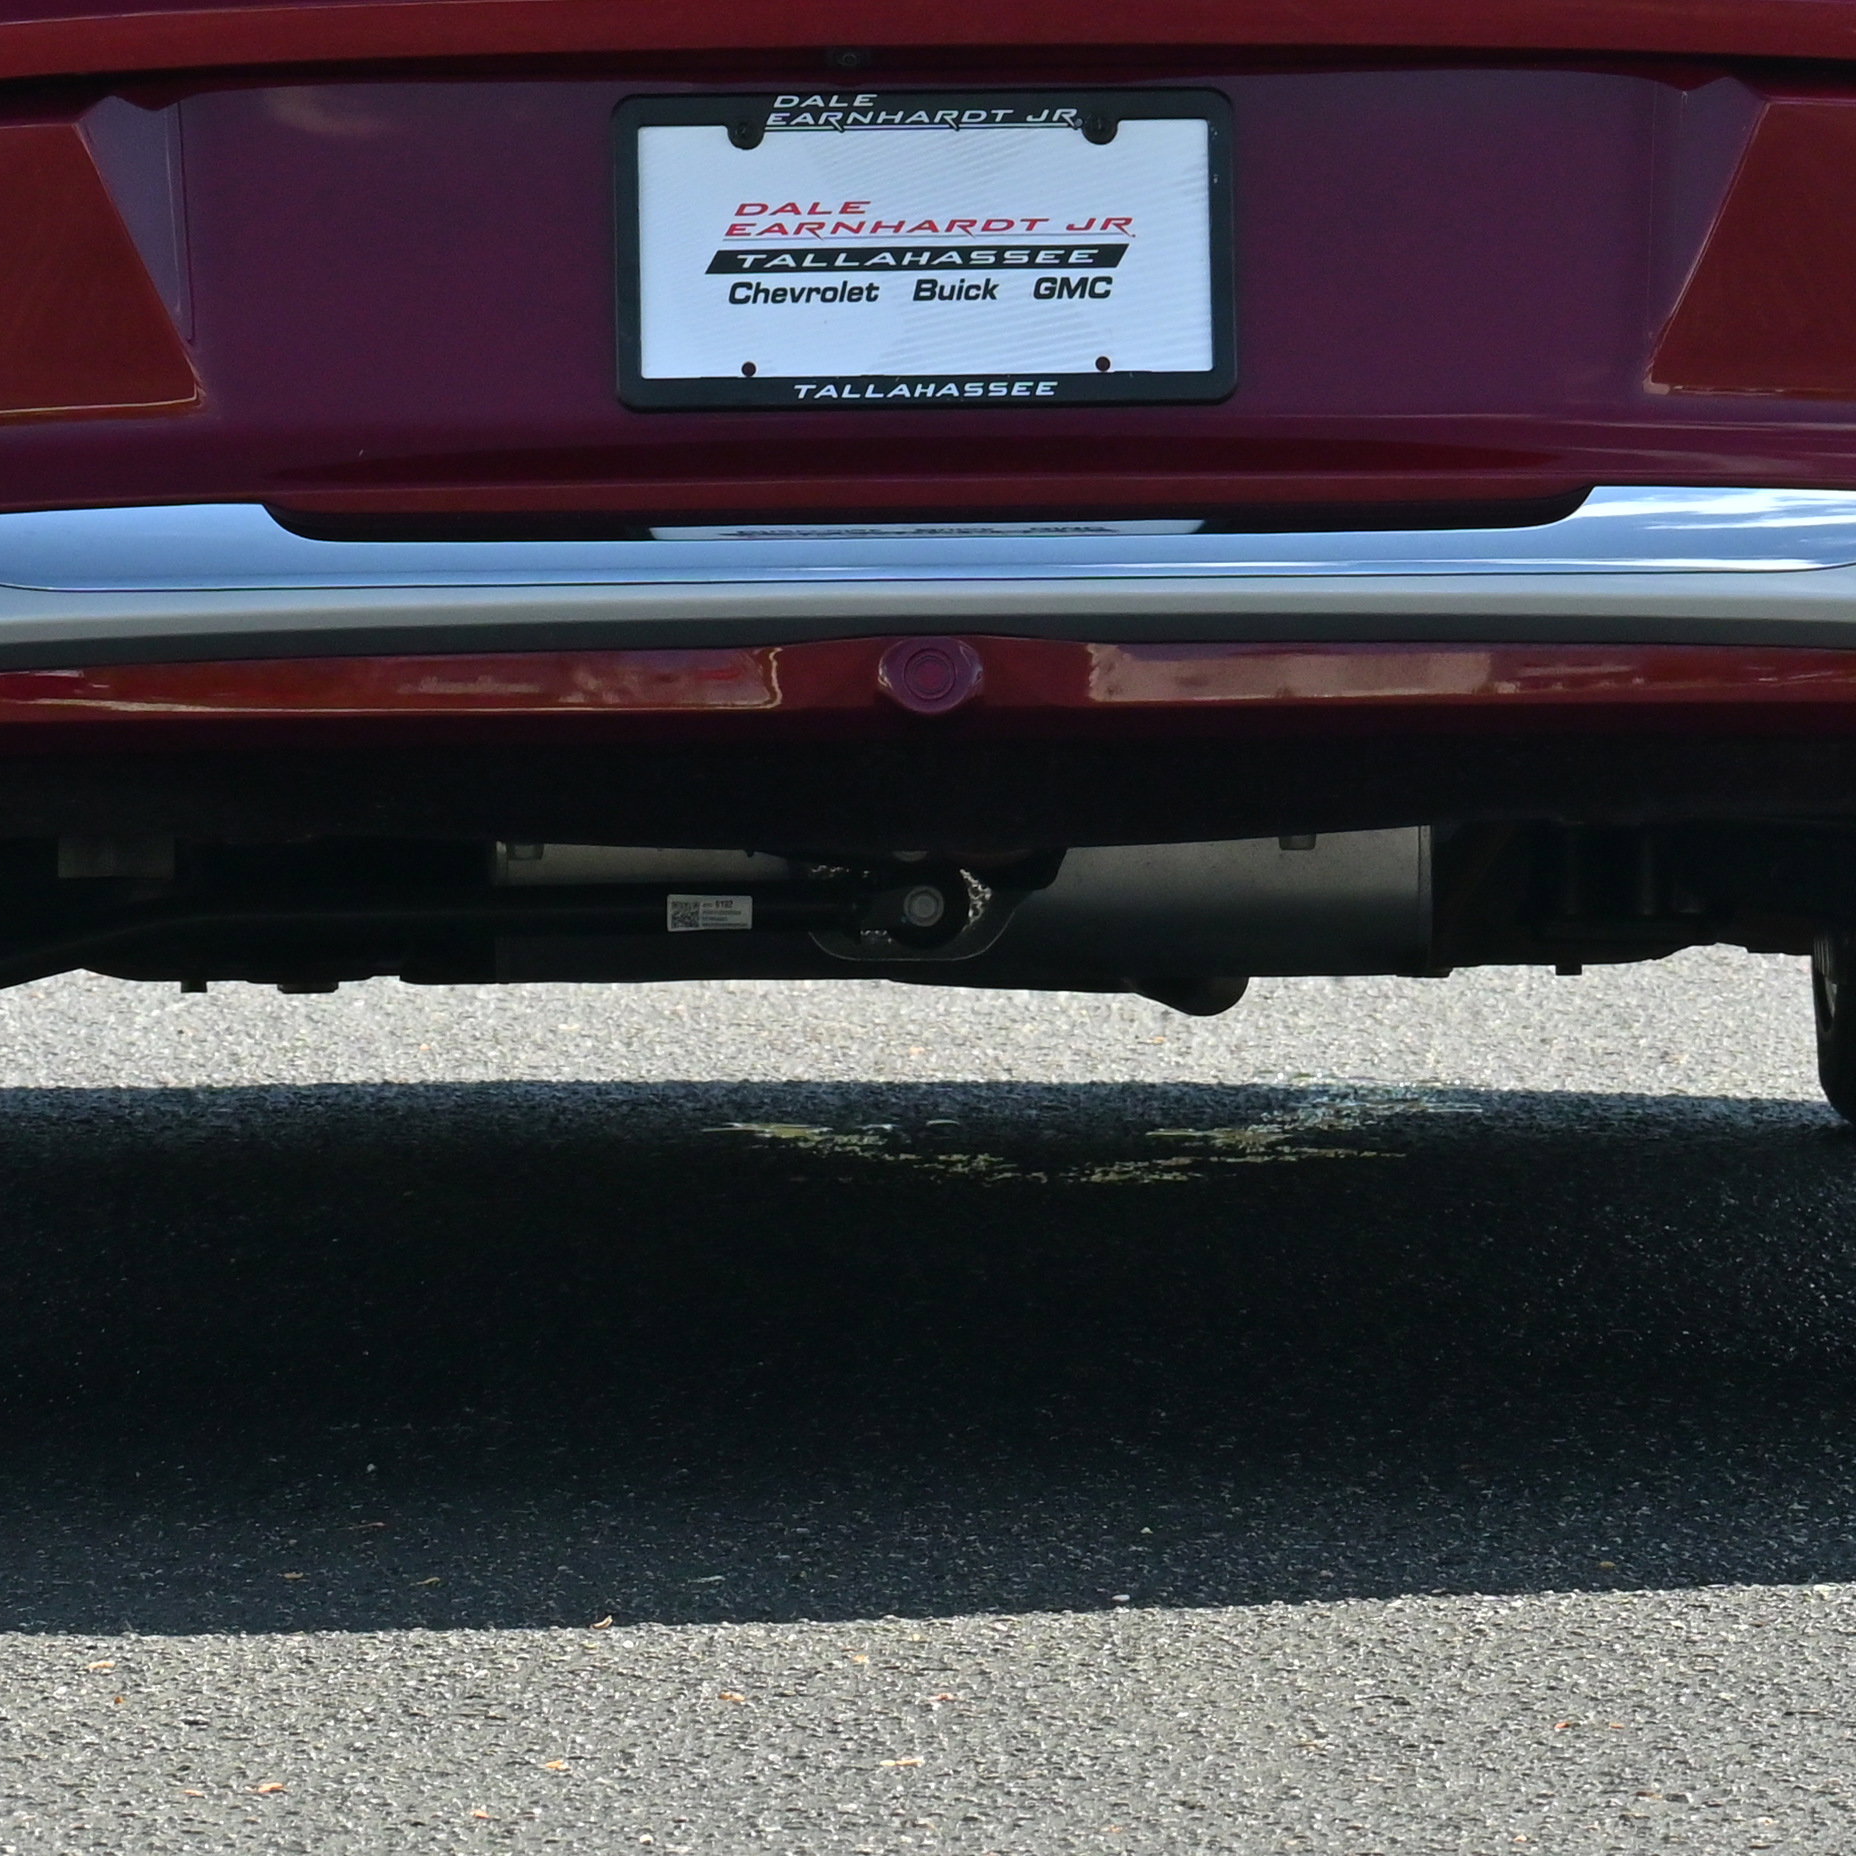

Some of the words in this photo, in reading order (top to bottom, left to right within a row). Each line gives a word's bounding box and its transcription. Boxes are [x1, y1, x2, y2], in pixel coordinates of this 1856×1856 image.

[773, 94, 878, 108] DALE
[765, 109, 1014, 132] EARNHARDT
[735, 201, 872, 217] DALE
[724, 217, 1050, 240] EARNHARDT
[736, 249, 1100, 269] TALLAHASSEE
[728, 280, 880, 305] Chevrolet
[912, 278, 999, 301] Buick
[1033, 276, 1113, 301] GMC
[794, 381, 1059, 400] TALLAHASSEE
